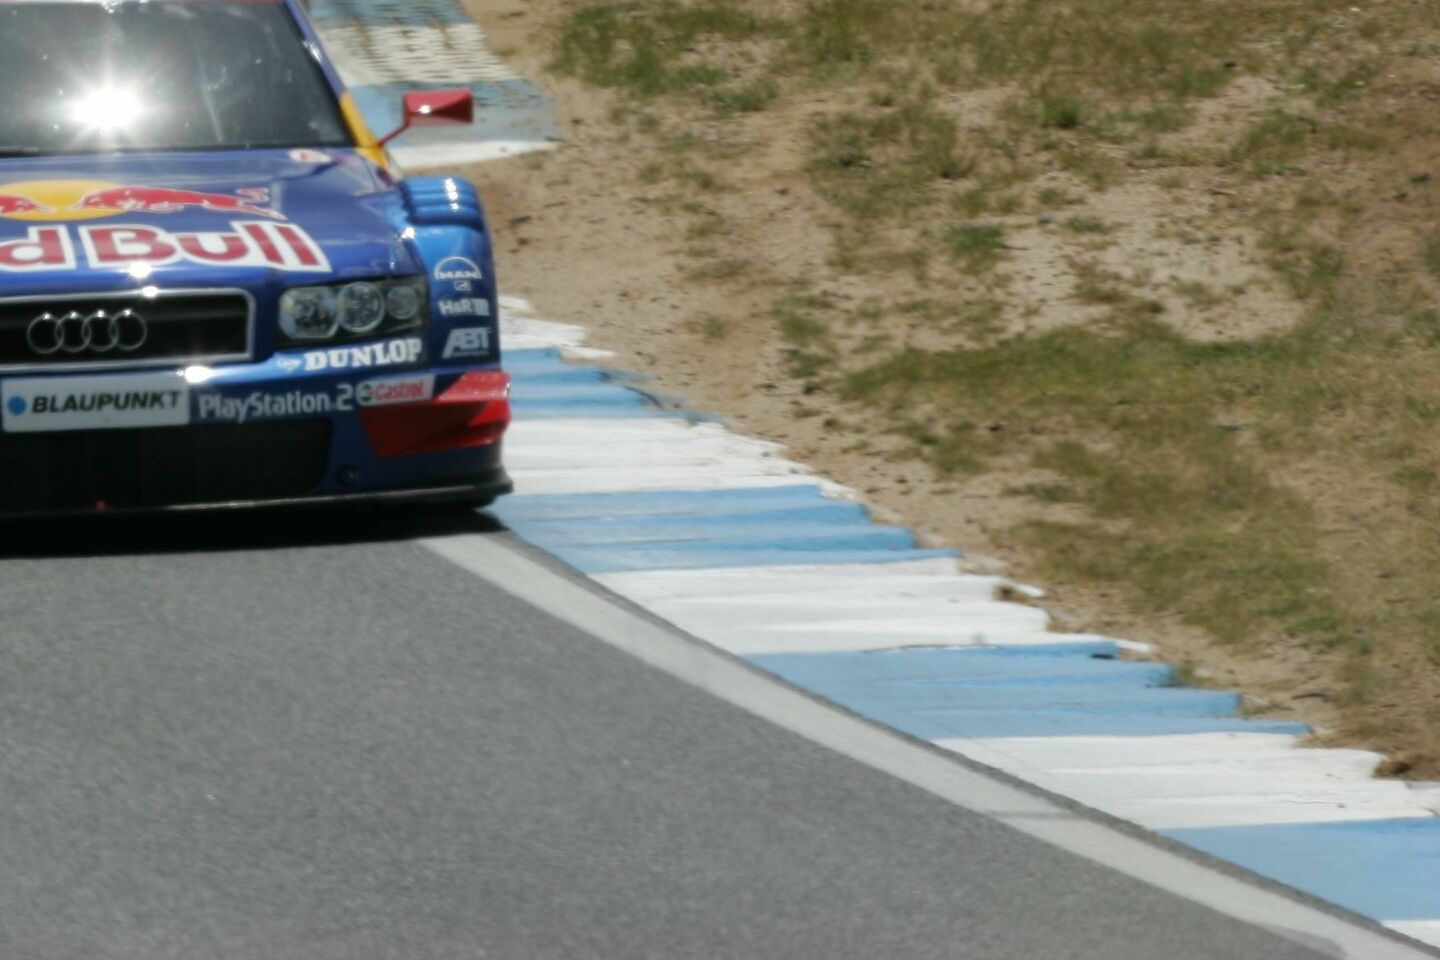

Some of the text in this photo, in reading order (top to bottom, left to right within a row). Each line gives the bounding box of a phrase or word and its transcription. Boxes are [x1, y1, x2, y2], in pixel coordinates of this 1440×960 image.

[79, 220, 332, 272] Bull
[304, 338, 423, 372] DUNLOP
[441, 327, 491, 359] ABT
[31, 390, 182, 414] BLAUPUNKT
[198, 387, 330, 424] PlayStation
[373, 377, 425, 401] Castrol
